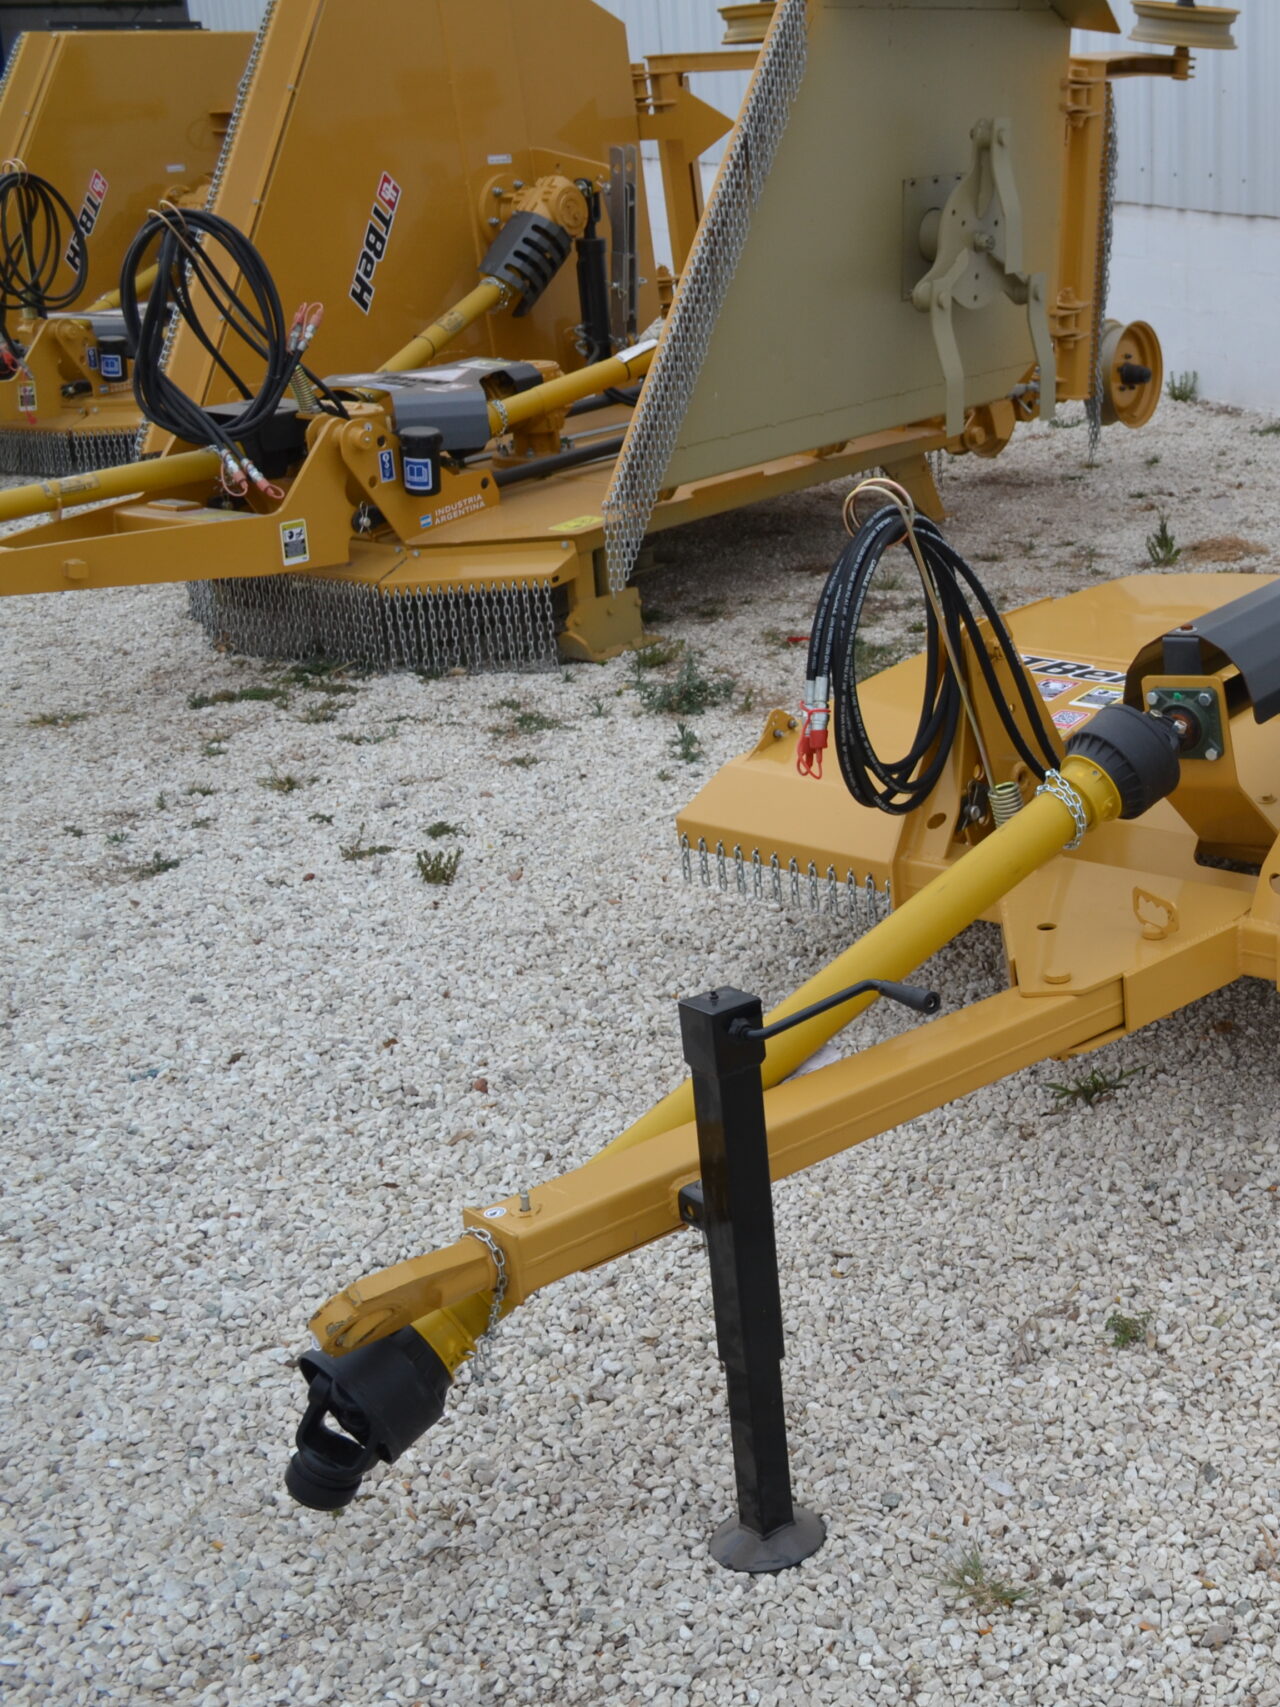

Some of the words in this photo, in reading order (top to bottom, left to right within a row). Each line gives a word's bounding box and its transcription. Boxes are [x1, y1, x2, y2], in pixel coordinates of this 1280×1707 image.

[65, 192, 102, 274] TBH
[434, 501, 486, 525] ARGENTINA
[435, 494, 482, 516] INDUSTRIA
